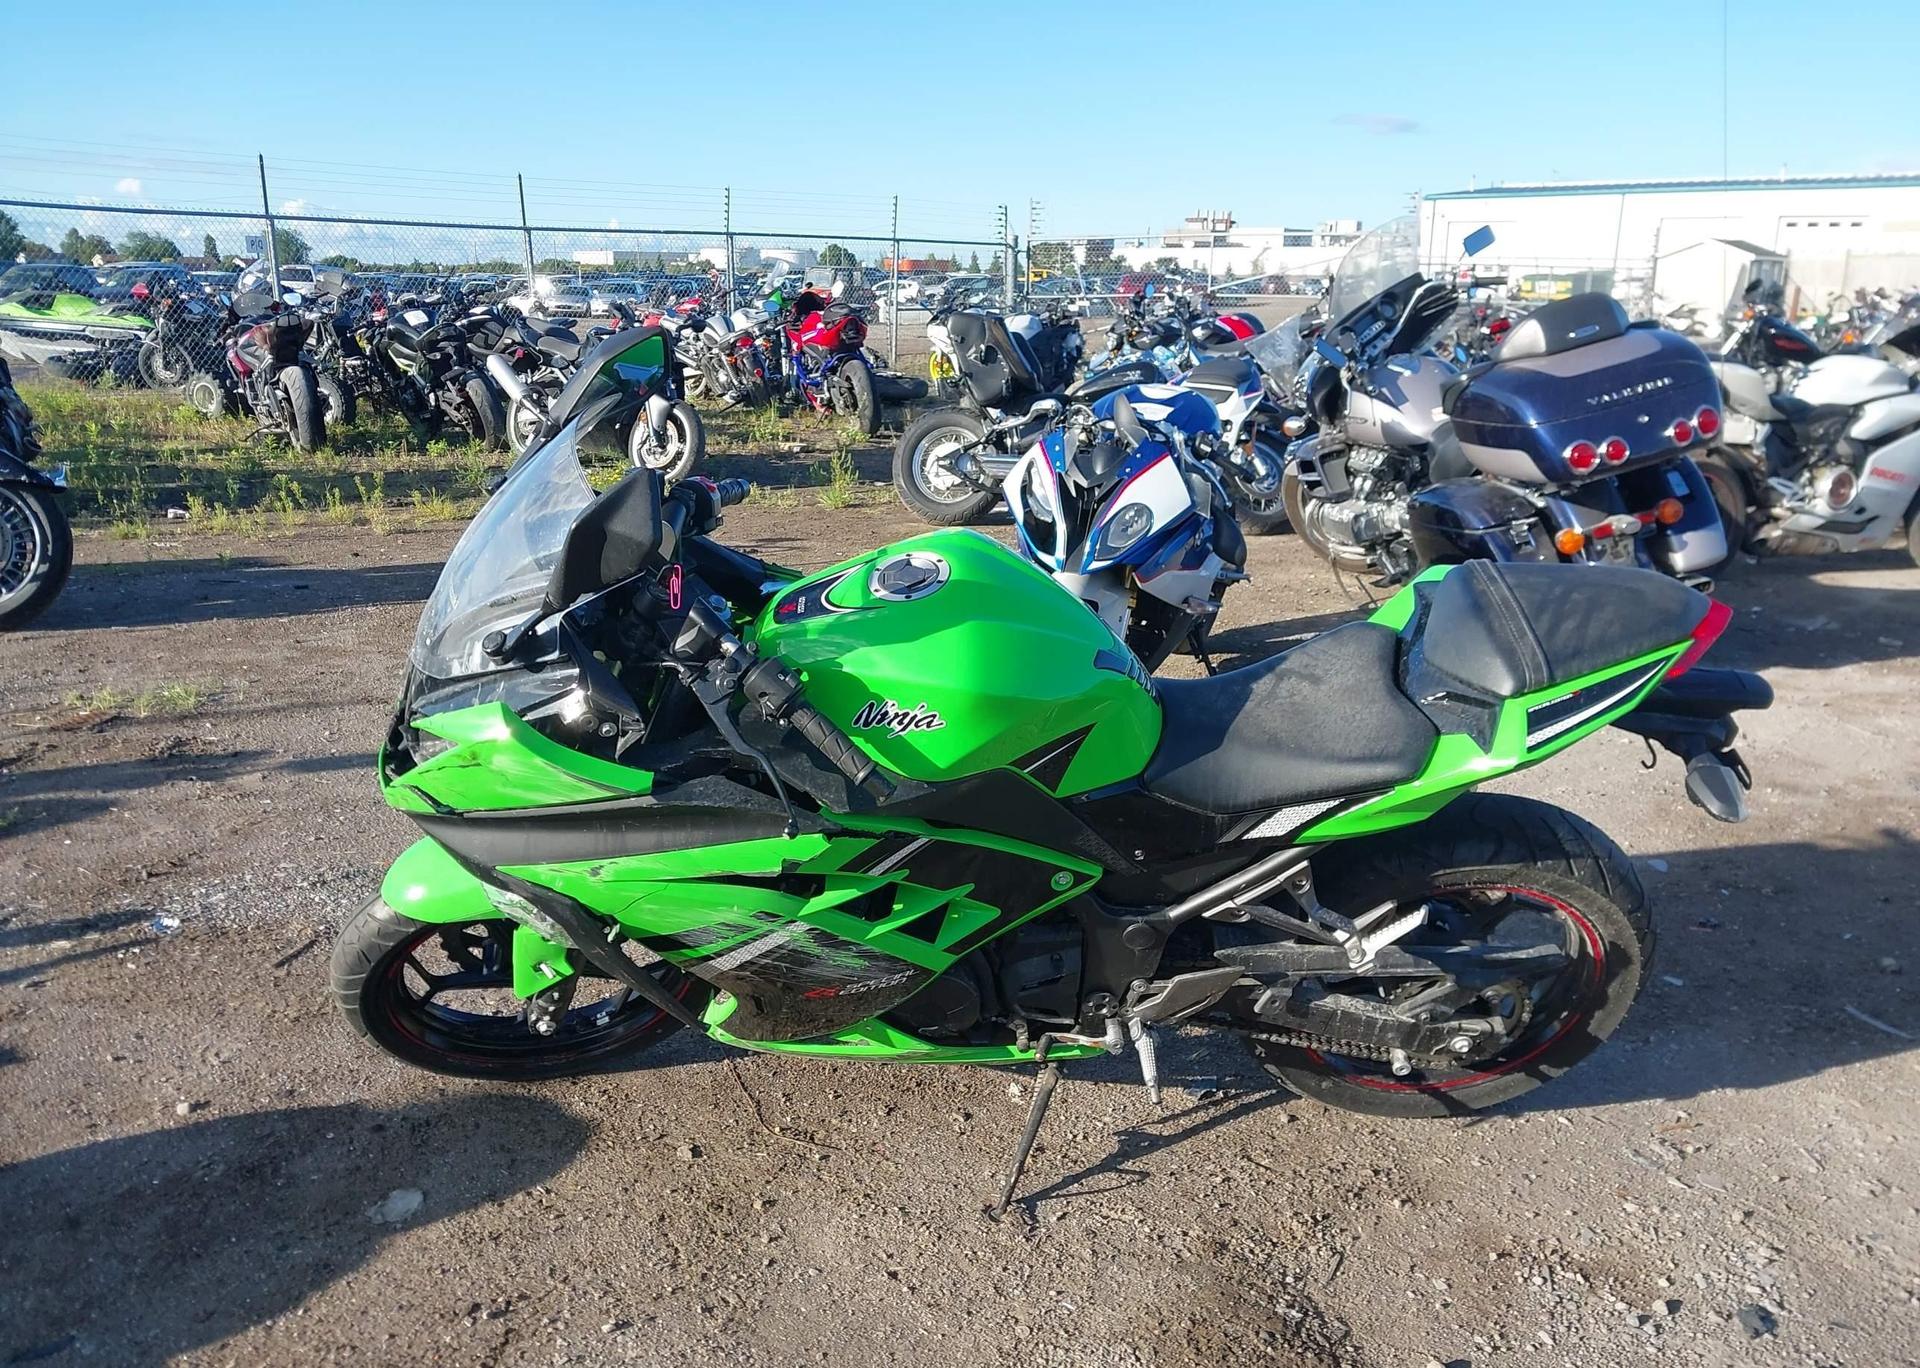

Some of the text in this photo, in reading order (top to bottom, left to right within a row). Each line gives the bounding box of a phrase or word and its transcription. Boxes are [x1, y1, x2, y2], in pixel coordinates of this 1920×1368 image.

[852, 700, 946, 738] Ninja
[839, 977, 908, 996] EDITION
[845, 969, 920, 988] SPECIAL
